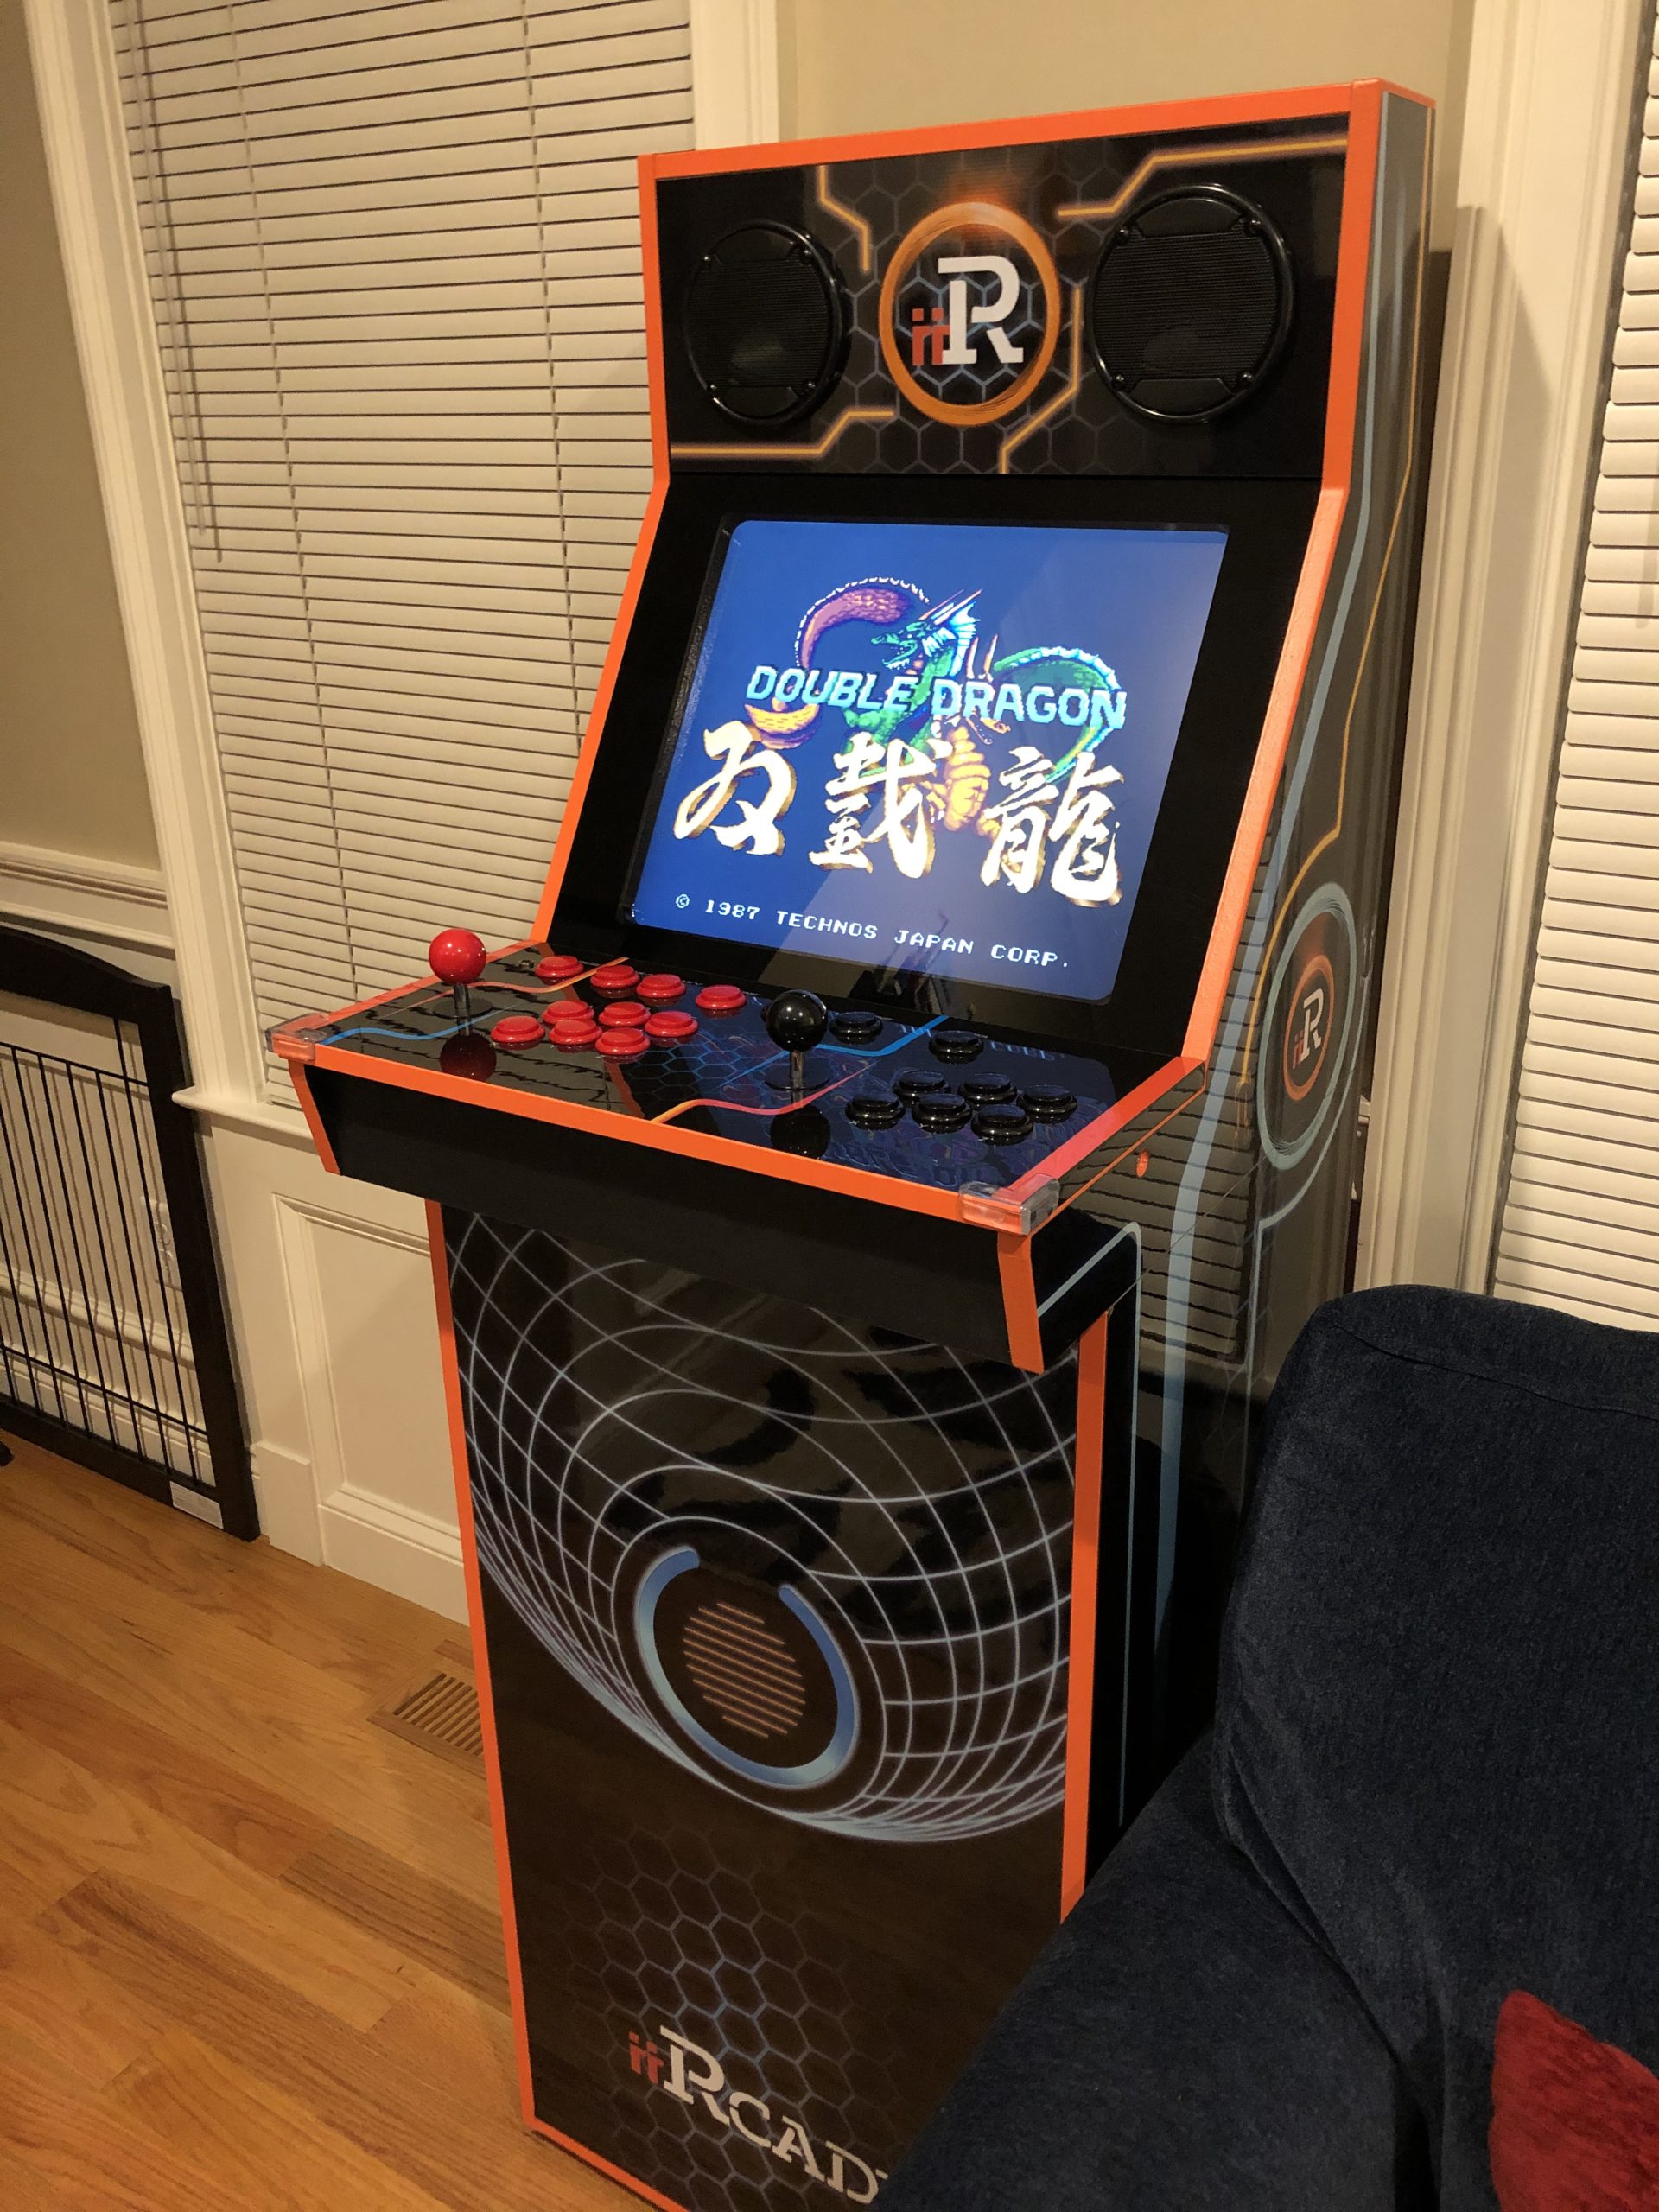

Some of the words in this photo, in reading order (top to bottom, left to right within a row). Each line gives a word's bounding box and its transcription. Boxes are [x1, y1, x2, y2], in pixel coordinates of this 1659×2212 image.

[746, 665, 922, 711] DOUBLE
[930, 678, 1128, 730] DRAGON
[705, 899, 760, 920] 1987
[777, 911, 879, 940] TECHNOS
[894, 930, 975, 955] JAPAN
[990, 944, 1069, 968] CORP.
[628, 2024, 889, 2205] iiRCAD
